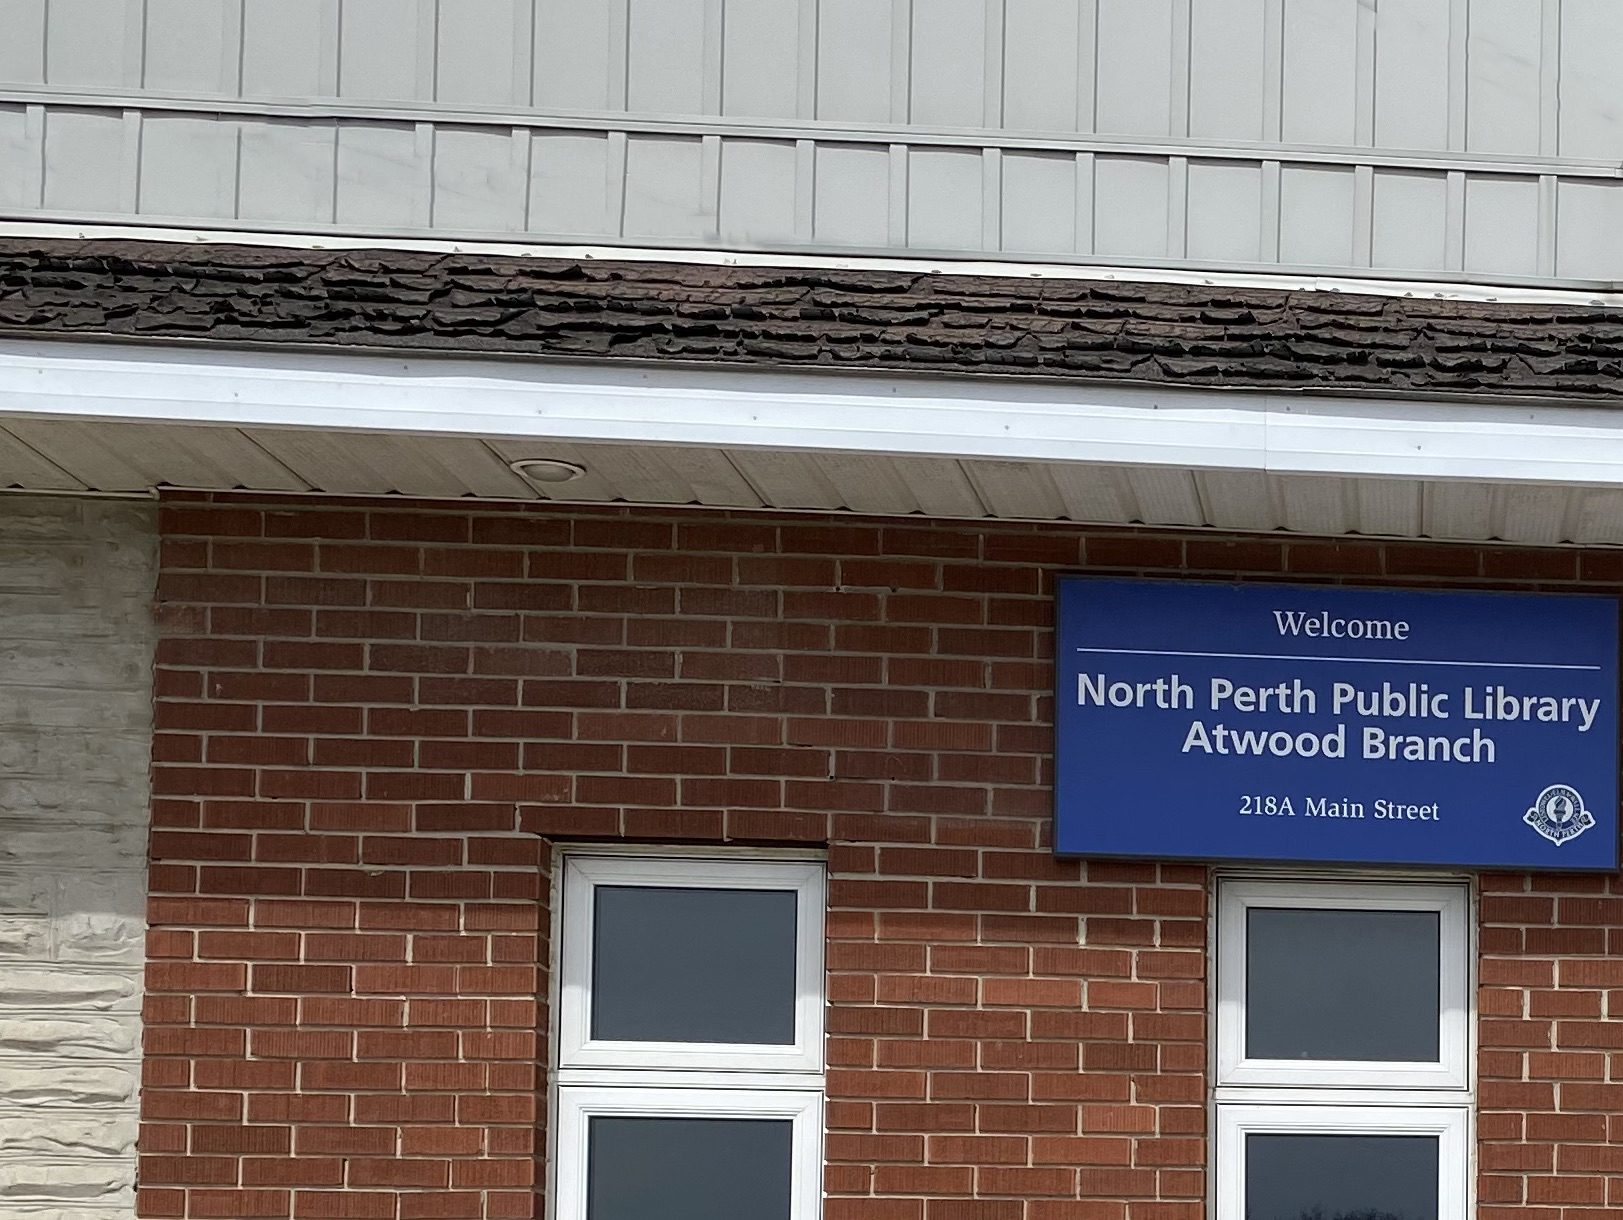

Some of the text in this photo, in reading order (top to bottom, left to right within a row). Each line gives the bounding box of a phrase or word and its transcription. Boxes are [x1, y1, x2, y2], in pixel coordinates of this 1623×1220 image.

[1273, 610, 1410, 641] Welcome
[1076, 673, 1601, 732] North Perth Public Library
[1181, 720, 1496, 763] Atwood Branch
[1239, 794, 1440, 822] 218A Main Street
[1535, 819, 1584, 838] NORTH PERTH
